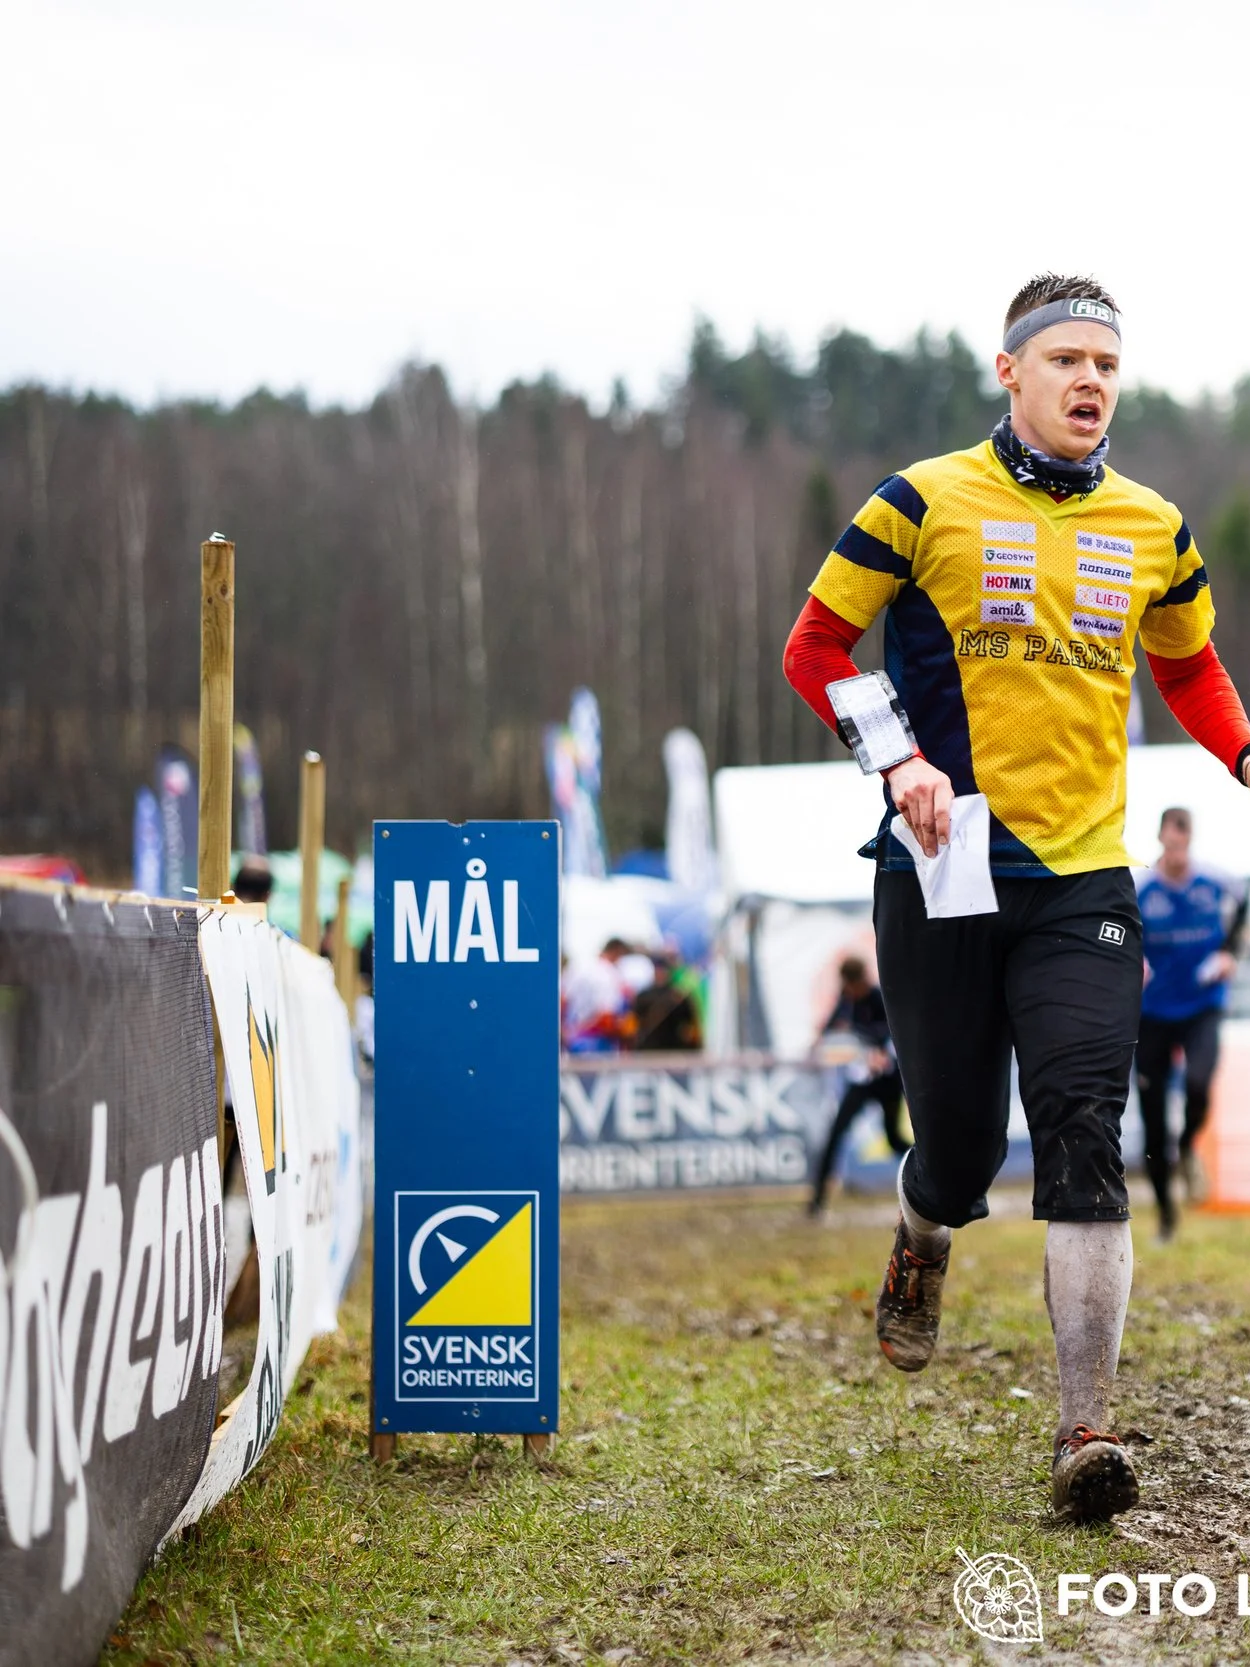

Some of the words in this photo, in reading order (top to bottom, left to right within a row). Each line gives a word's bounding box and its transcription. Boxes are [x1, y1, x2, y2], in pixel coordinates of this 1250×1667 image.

[996, 552, 1034, 562] GEOSYNT
[1078, 563, 1132, 579] noname
[985, 575, 1032, 590] HOTMIX
[1095, 592, 1129, 608] LIETO
[989, 602, 1027, 617] amili
[958, 629, 1010, 659] MS
[1024, 634, 1126, 673] PARMA
[393, 857, 540, 963] MÅL
[560, 1135, 807, 1192] RIENTERING
[402, 1334, 533, 1365] SVENSK
[401, 1368, 534, 1387] ORIENTERING
